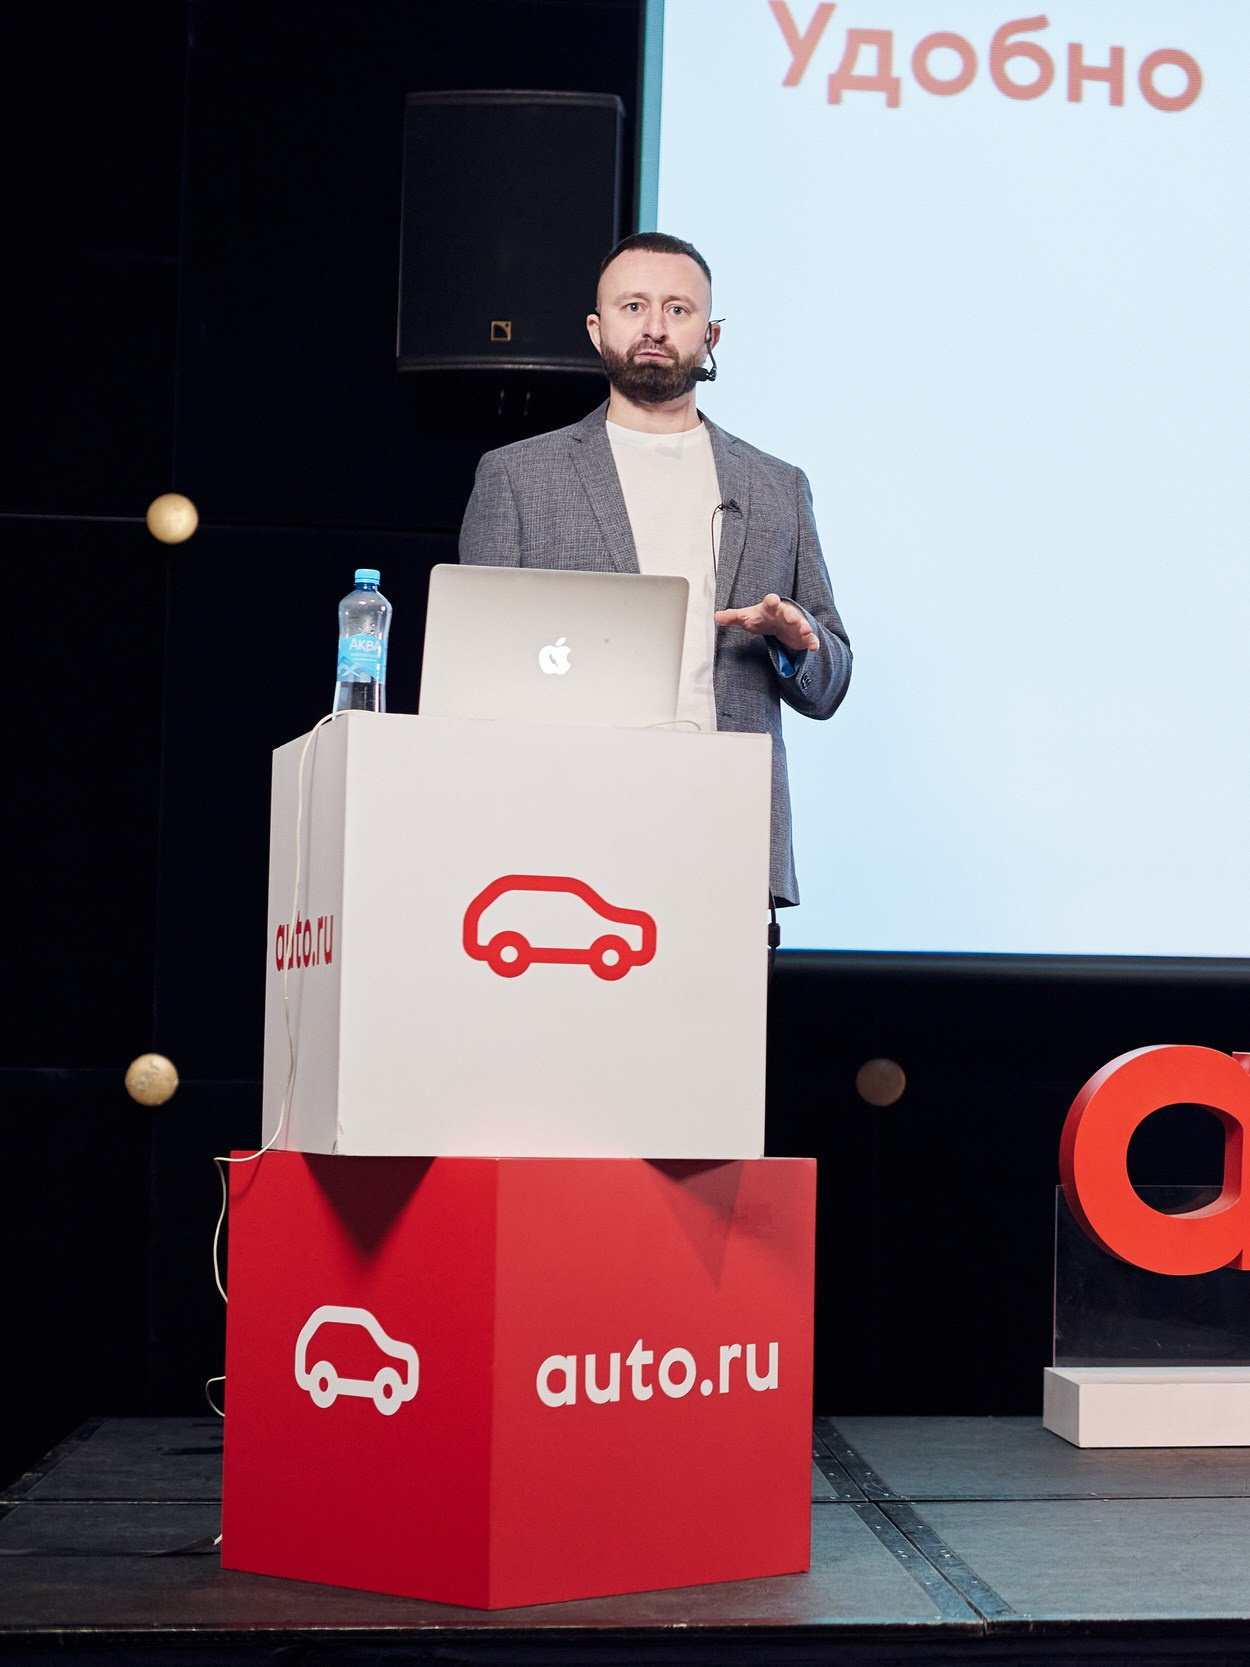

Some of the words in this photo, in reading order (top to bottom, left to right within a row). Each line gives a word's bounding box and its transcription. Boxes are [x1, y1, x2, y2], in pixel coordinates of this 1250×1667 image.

[768, 0, 1203, 112] Удобно
[276, 910, 334, 971] auto.ru
[536, 1339, 779, 1408] auto.ru
